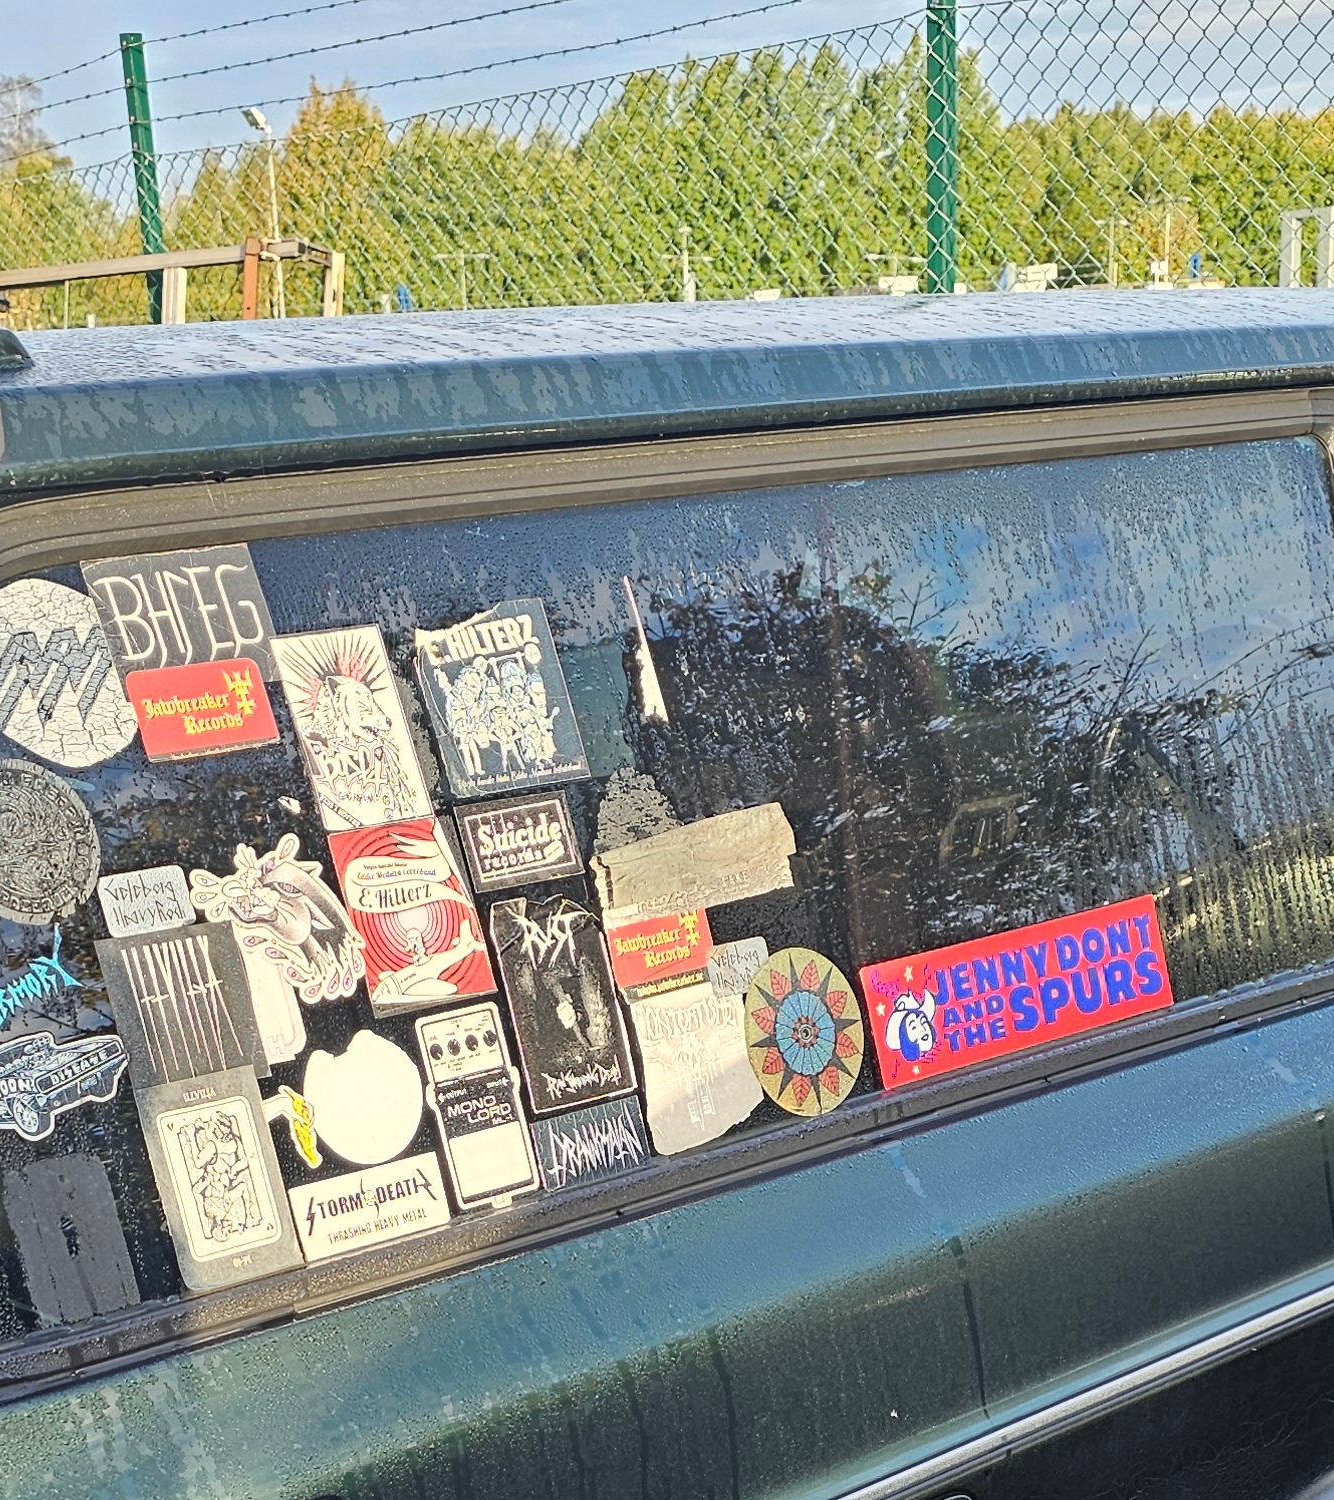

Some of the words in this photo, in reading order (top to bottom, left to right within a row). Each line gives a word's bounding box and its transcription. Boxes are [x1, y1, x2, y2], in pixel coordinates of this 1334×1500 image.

[141, 693, 230, 720] Jawbreaker
[182, 712, 244, 736] Records
[477, 812, 562, 855] Suicide
[483, 849, 543, 871] records
[613, 928, 681, 956] Jawbreaker
[644, 944, 691, 969] Records
[934, 941, 1048, 1006] JENNY
[1055, 914, 1151, 972] DON'T
[1009, 951, 1164, 1032] SPURS
[943, 994, 1005, 1028] AND
[944, 1017, 1007, 1052] THE
[447, 1095, 497, 1118] MONO
[467, 1102, 512, 1124] LORD
[327, 1222, 373, 1245] THRASHING
[374, 1214, 400, 1231] HEAVY
[402, 1207, 428, 1224] METAL
